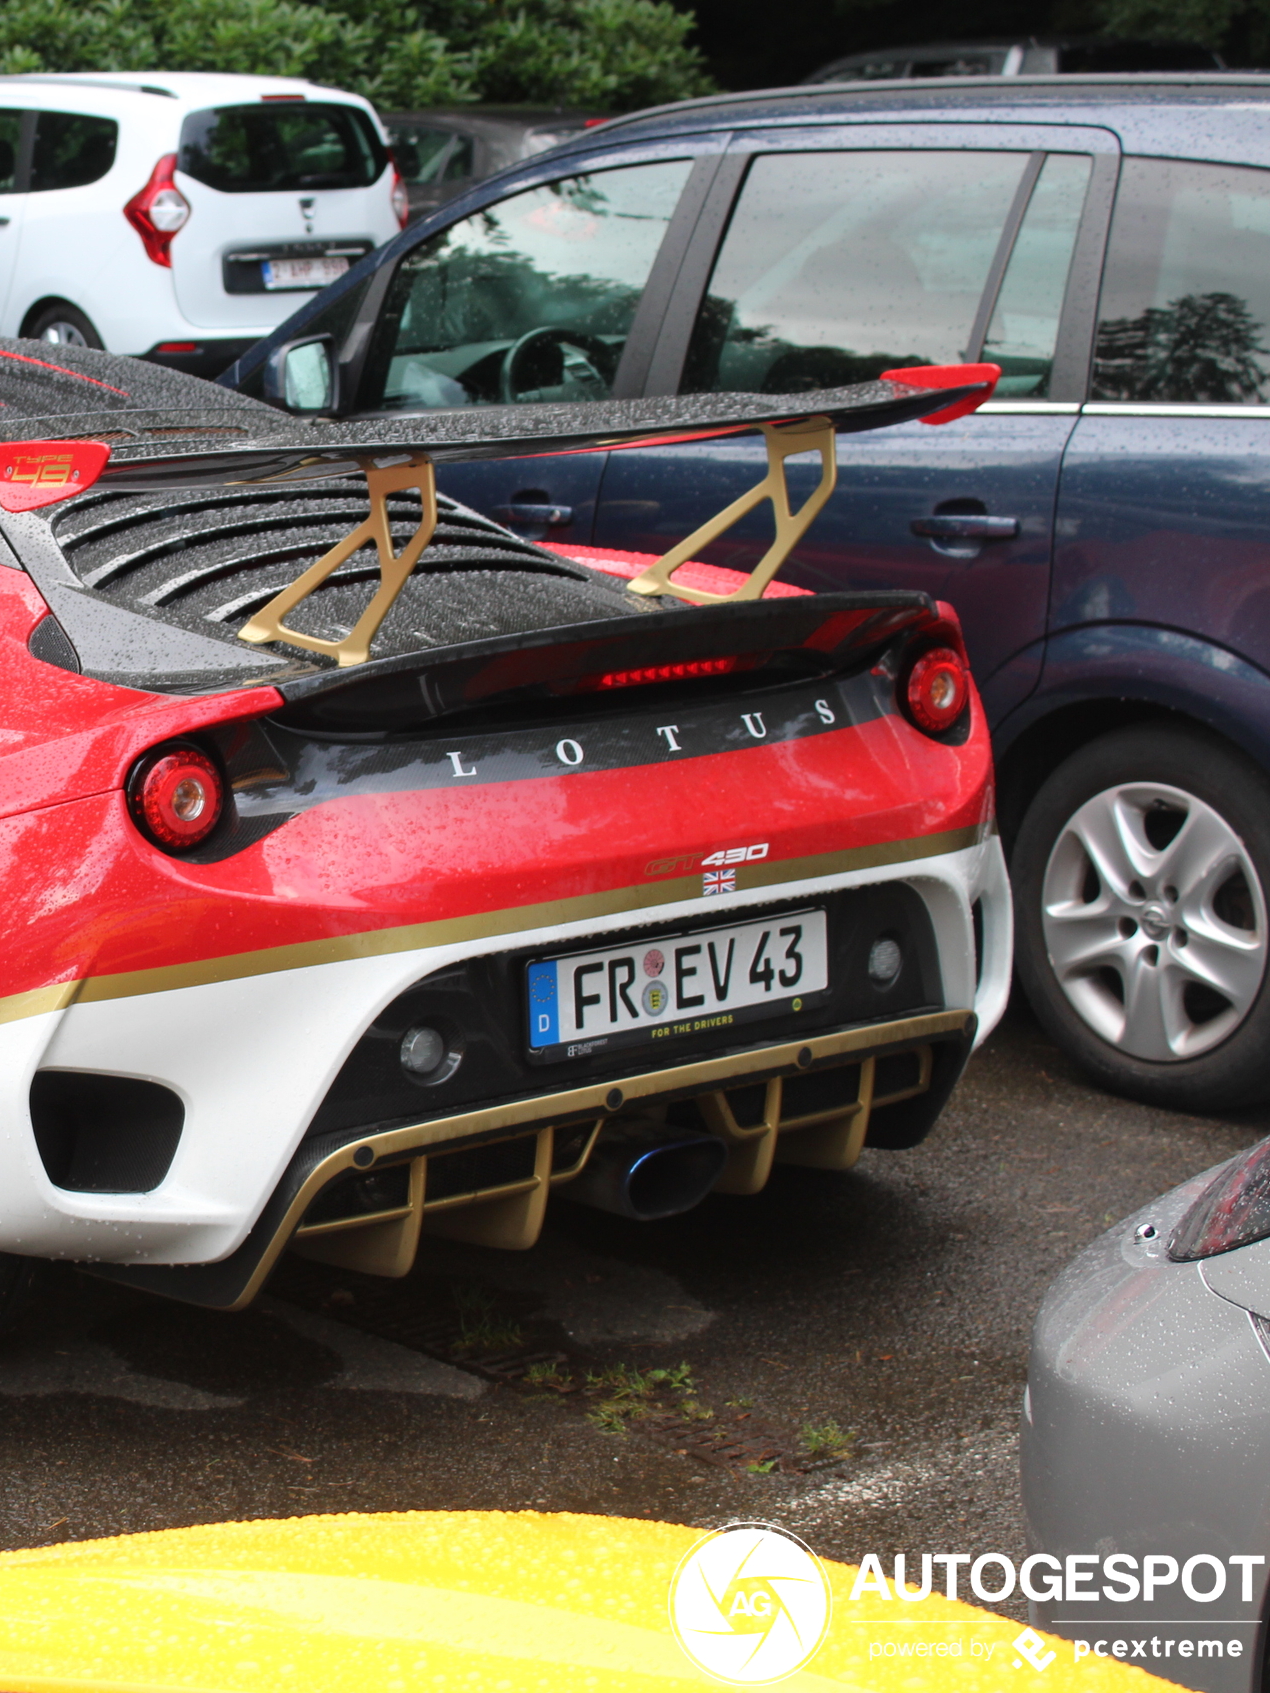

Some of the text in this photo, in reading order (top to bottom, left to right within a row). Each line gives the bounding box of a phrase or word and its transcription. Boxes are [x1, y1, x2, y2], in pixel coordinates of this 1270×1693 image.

[13, 454, 74, 464] TYPE
[11, 464, 71, 488] 49
[446, 699, 836, 778] LOTUS
[538, 924, 803, 1033] D FR EV 43
[651, 1015, 734, 1039] FOR THE DRIVERS
